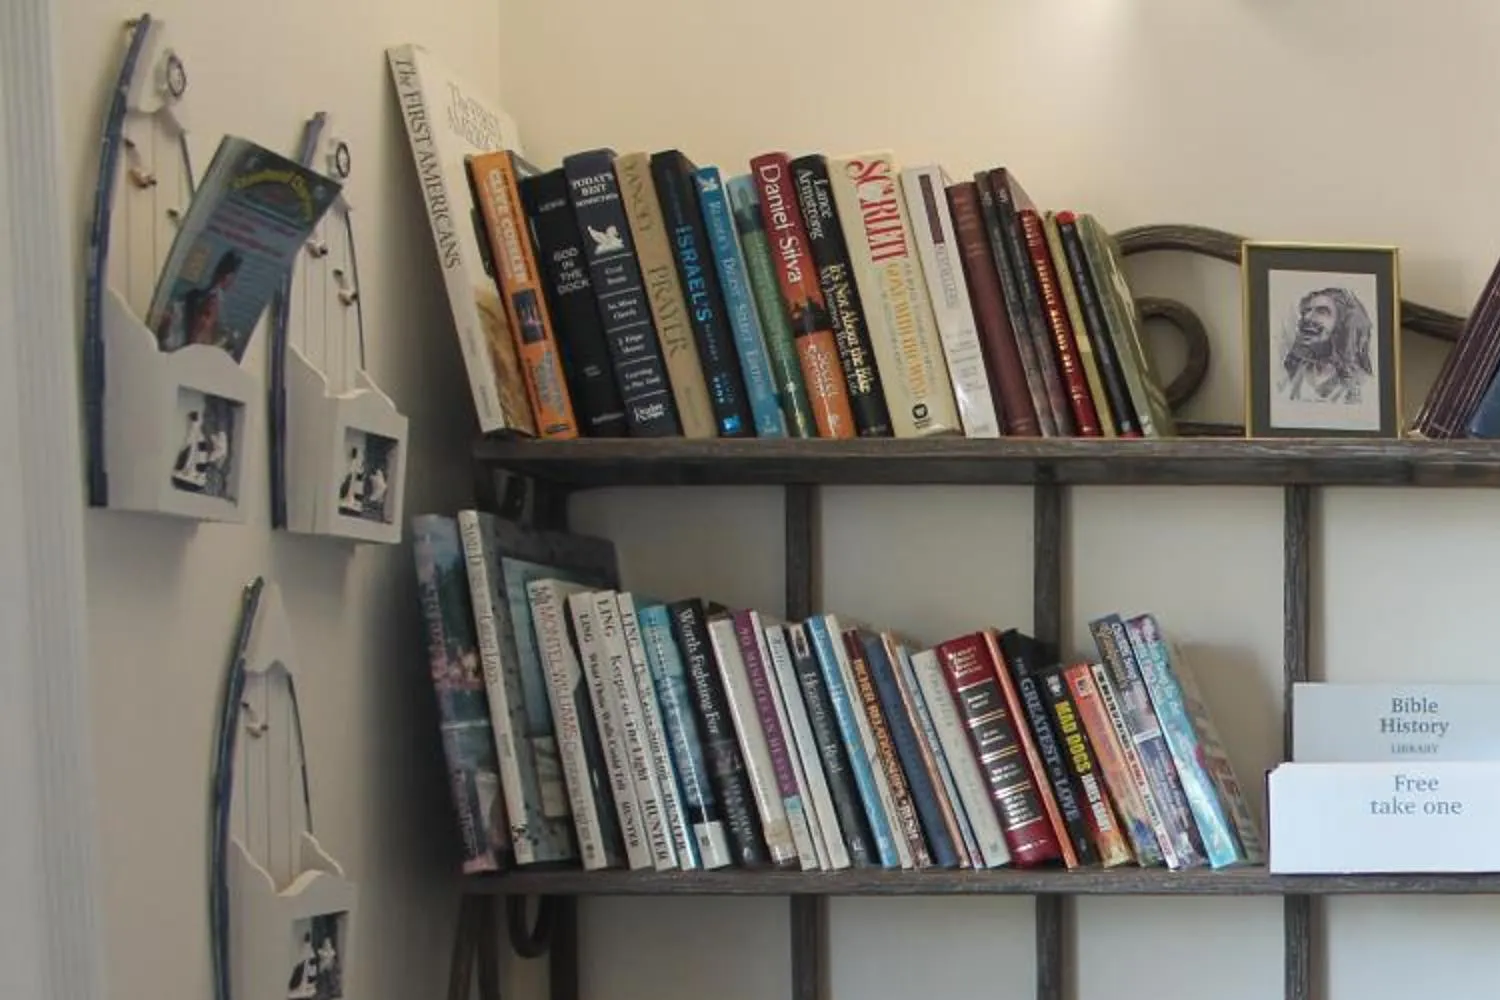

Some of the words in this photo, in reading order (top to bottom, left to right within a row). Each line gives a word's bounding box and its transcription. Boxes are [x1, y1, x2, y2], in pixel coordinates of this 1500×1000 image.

[404, 89, 434, 145] FIRST
[415, 144, 463, 272] AMERICANS
[811, 177, 834, 220] Lance
[757, 162, 789, 230] Daniel
[777, 228, 804, 285] Silva
[674, 224, 715, 325] ISRAEL'S
[647, 265, 690, 360] PRAYER
[682, 606, 704, 653] Worth
[690, 653, 718, 709] Fighting
[703, 709, 724, 737] For
[1054, 699, 1078, 732] MAD
[1379, 717, 1450, 737] History
[1390, 697, 1440, 715] Bible
[1018, 676, 1060, 767] GREATEST
[1052, 775, 1079, 822] LOVE
[1065, 730, 1091, 775] DOGS
[1390, 743, 1440, 755] LIBRARY
[1393, 774, 1440, 792] Free
[643, 797, 668, 862] HUNTER
[1370, 799, 1418, 816] take
[1423, 802, 1464, 816] one
